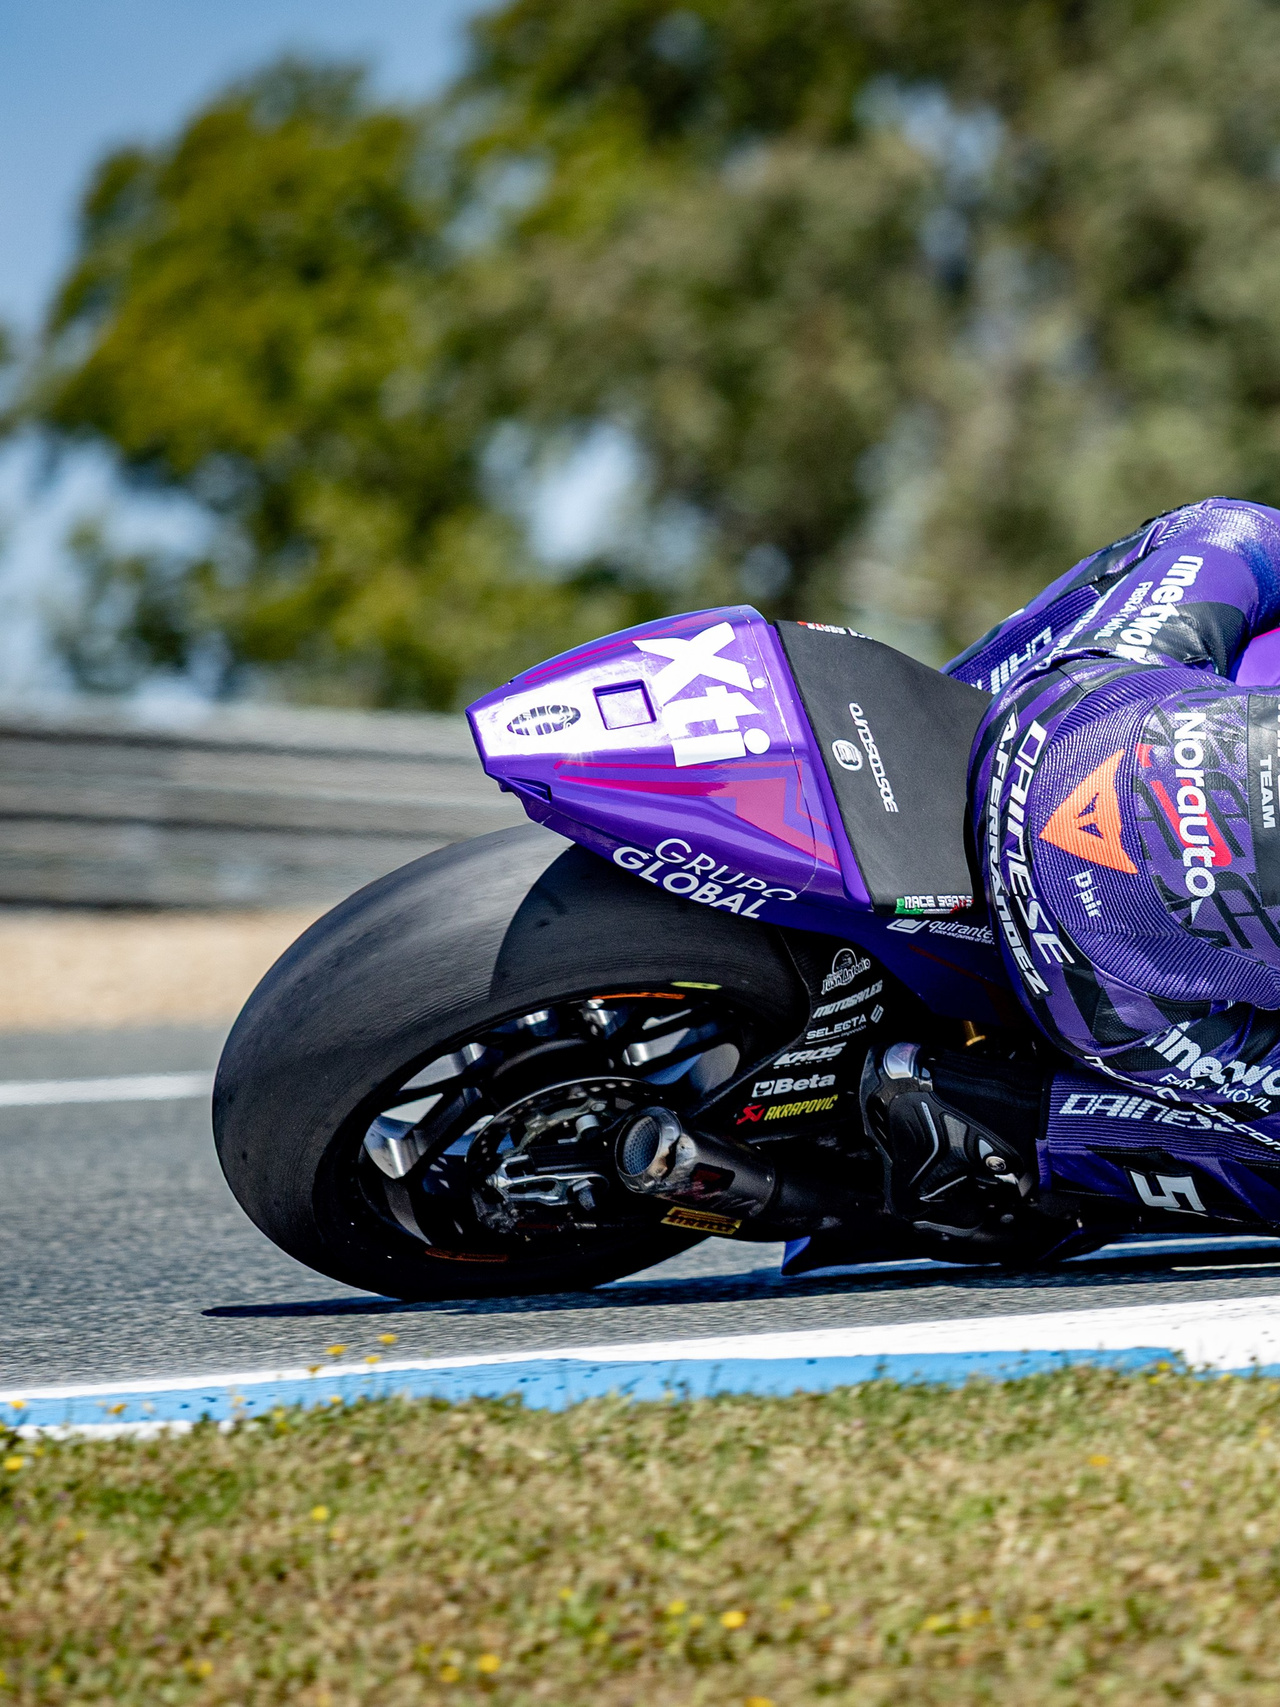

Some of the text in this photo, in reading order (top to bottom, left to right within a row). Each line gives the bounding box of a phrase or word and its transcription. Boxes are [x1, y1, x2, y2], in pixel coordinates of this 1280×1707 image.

[1174, 712, 1216, 898] Norauto
[1260, 755, 1276, 829] TEAM
[655, 838, 797, 901] GRUPO
[1006, 719, 1075, 964] DAINESE
[612, 846, 768, 919] GLOBAL
[806, 1013, 867, 1039] SELECTA
[773, 1074, 836, 1095] Beta
